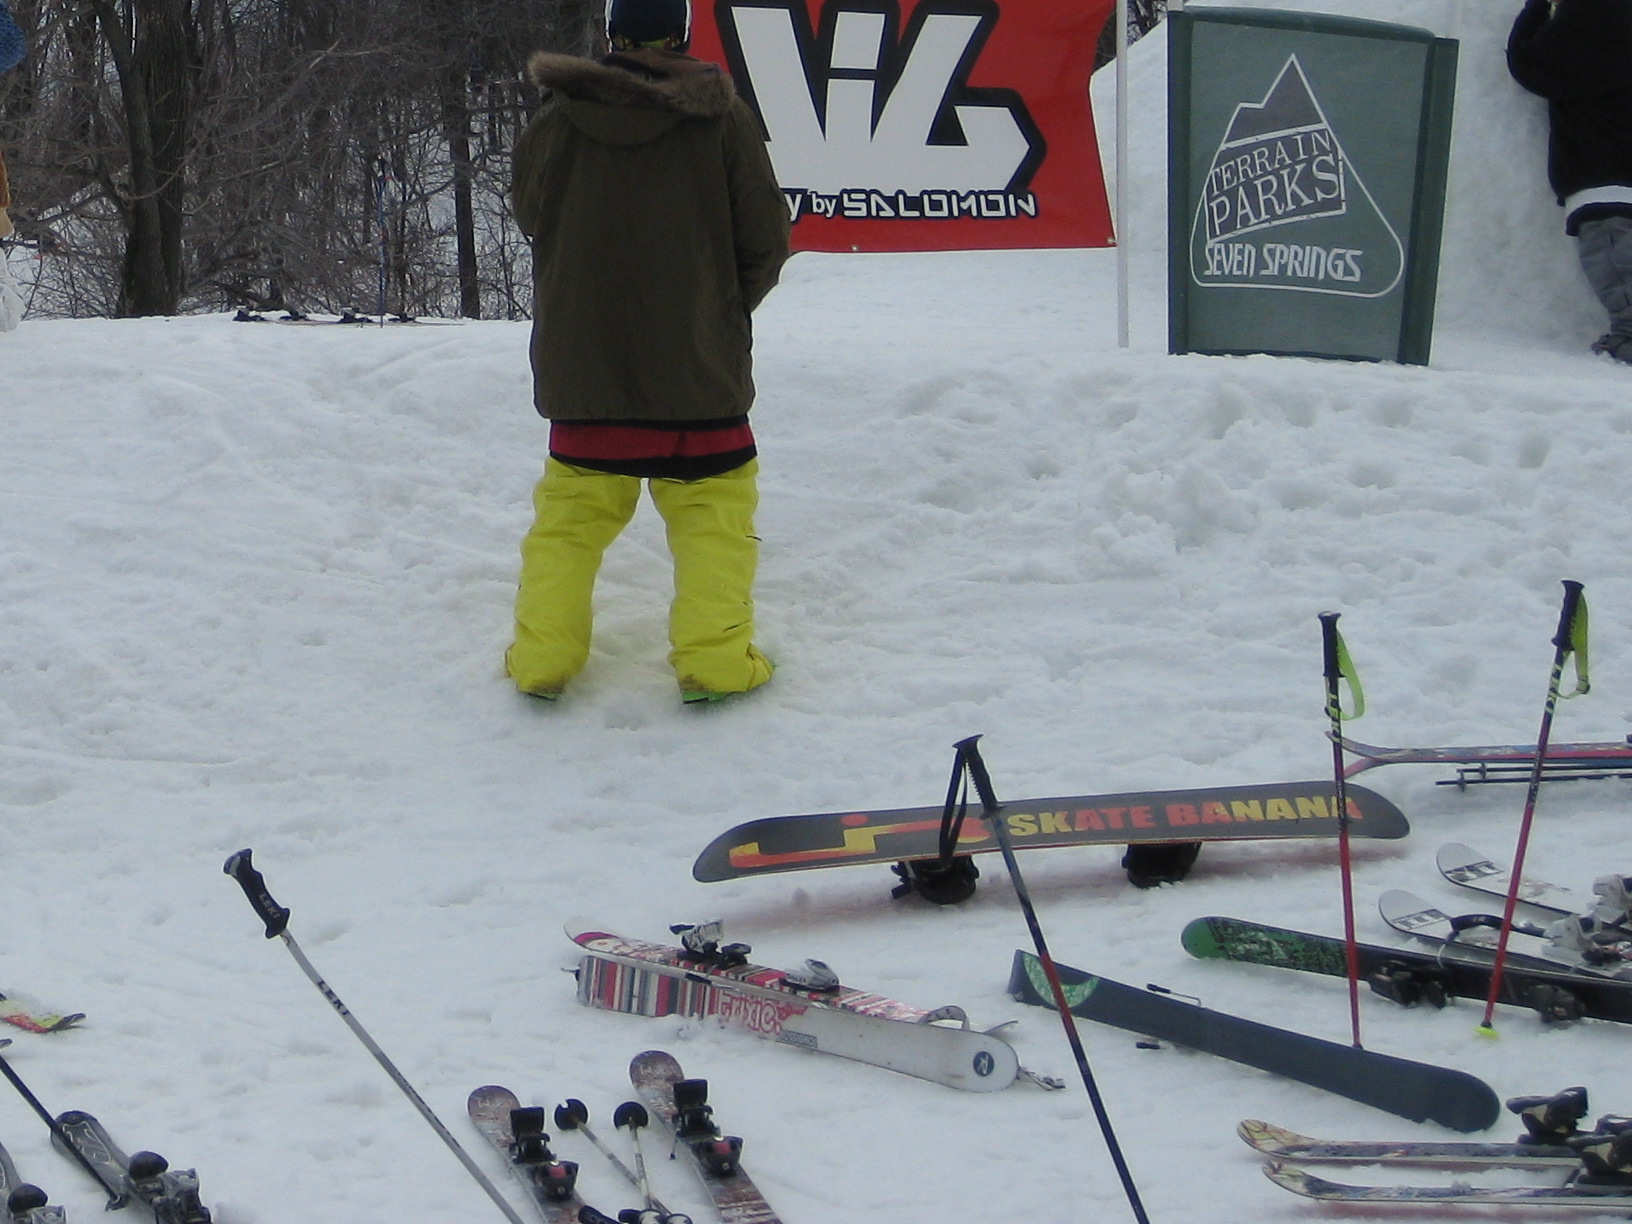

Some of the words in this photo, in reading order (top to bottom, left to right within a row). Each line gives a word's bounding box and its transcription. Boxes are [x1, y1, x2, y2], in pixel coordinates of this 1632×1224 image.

[1210, 130, 1331, 196] TERRAIN
[811, 192, 837, 218] by
[842, 192, 1037, 218] SALOMON
[1209, 155, 1340, 236] PARKS
[1205, 243, 1255, 277] SEVEN
[1260, 243, 1363, 282] SPRINGS
[1006, 804, 1157, 837] SKATE
[1165, 795, 1365, 827] BANANA
[317, 979, 351, 1016] LEKI
